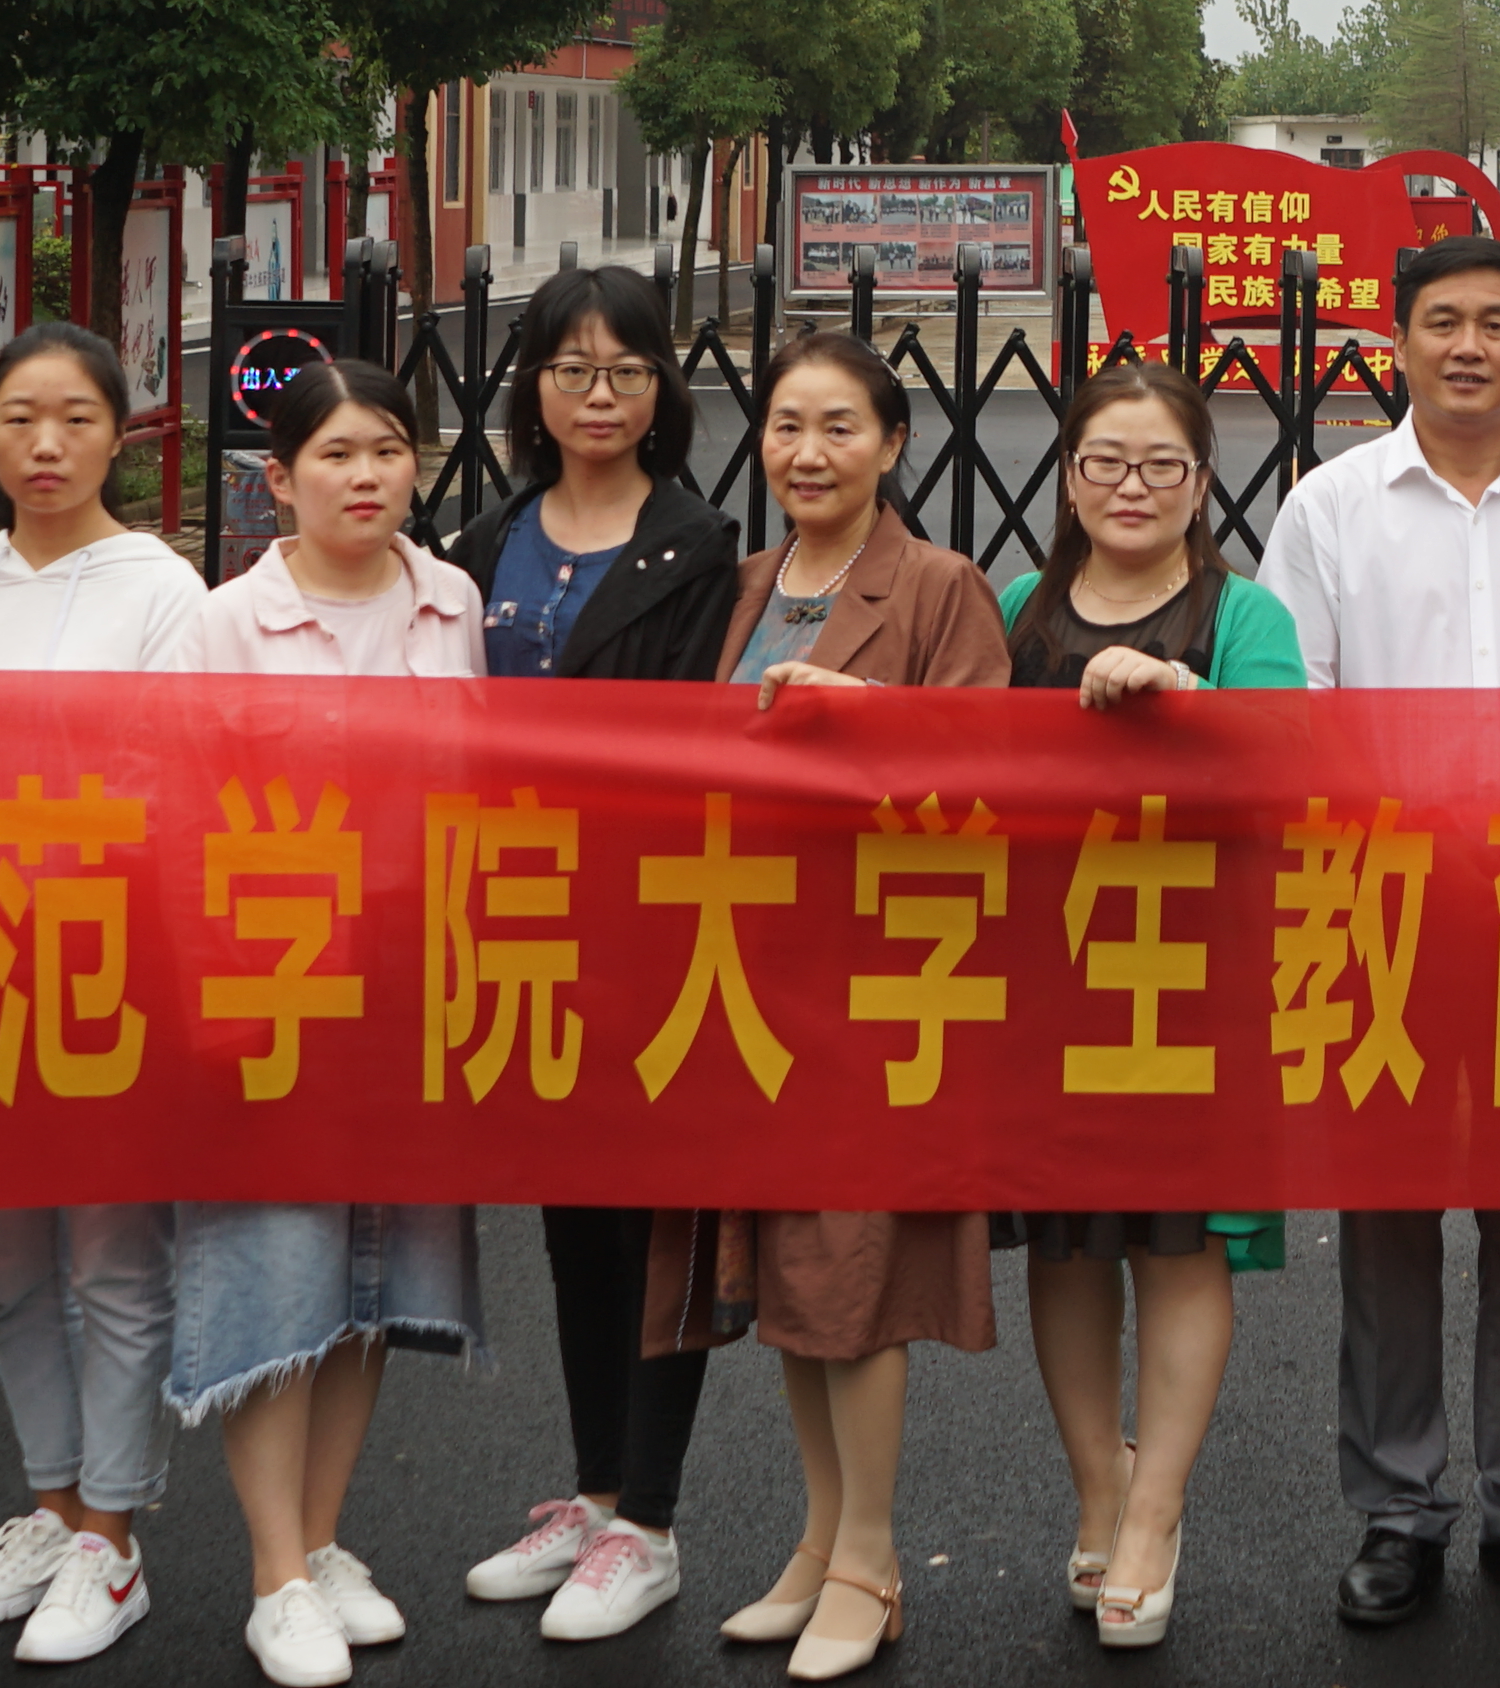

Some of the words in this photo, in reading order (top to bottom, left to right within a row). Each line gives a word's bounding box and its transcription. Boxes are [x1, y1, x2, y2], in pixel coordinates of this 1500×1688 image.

[817, 176, 861, 190] 新时代
[1138, 189, 1311, 223] 人民有信仰
[1207, 275, 1380, 310] 民族希望
